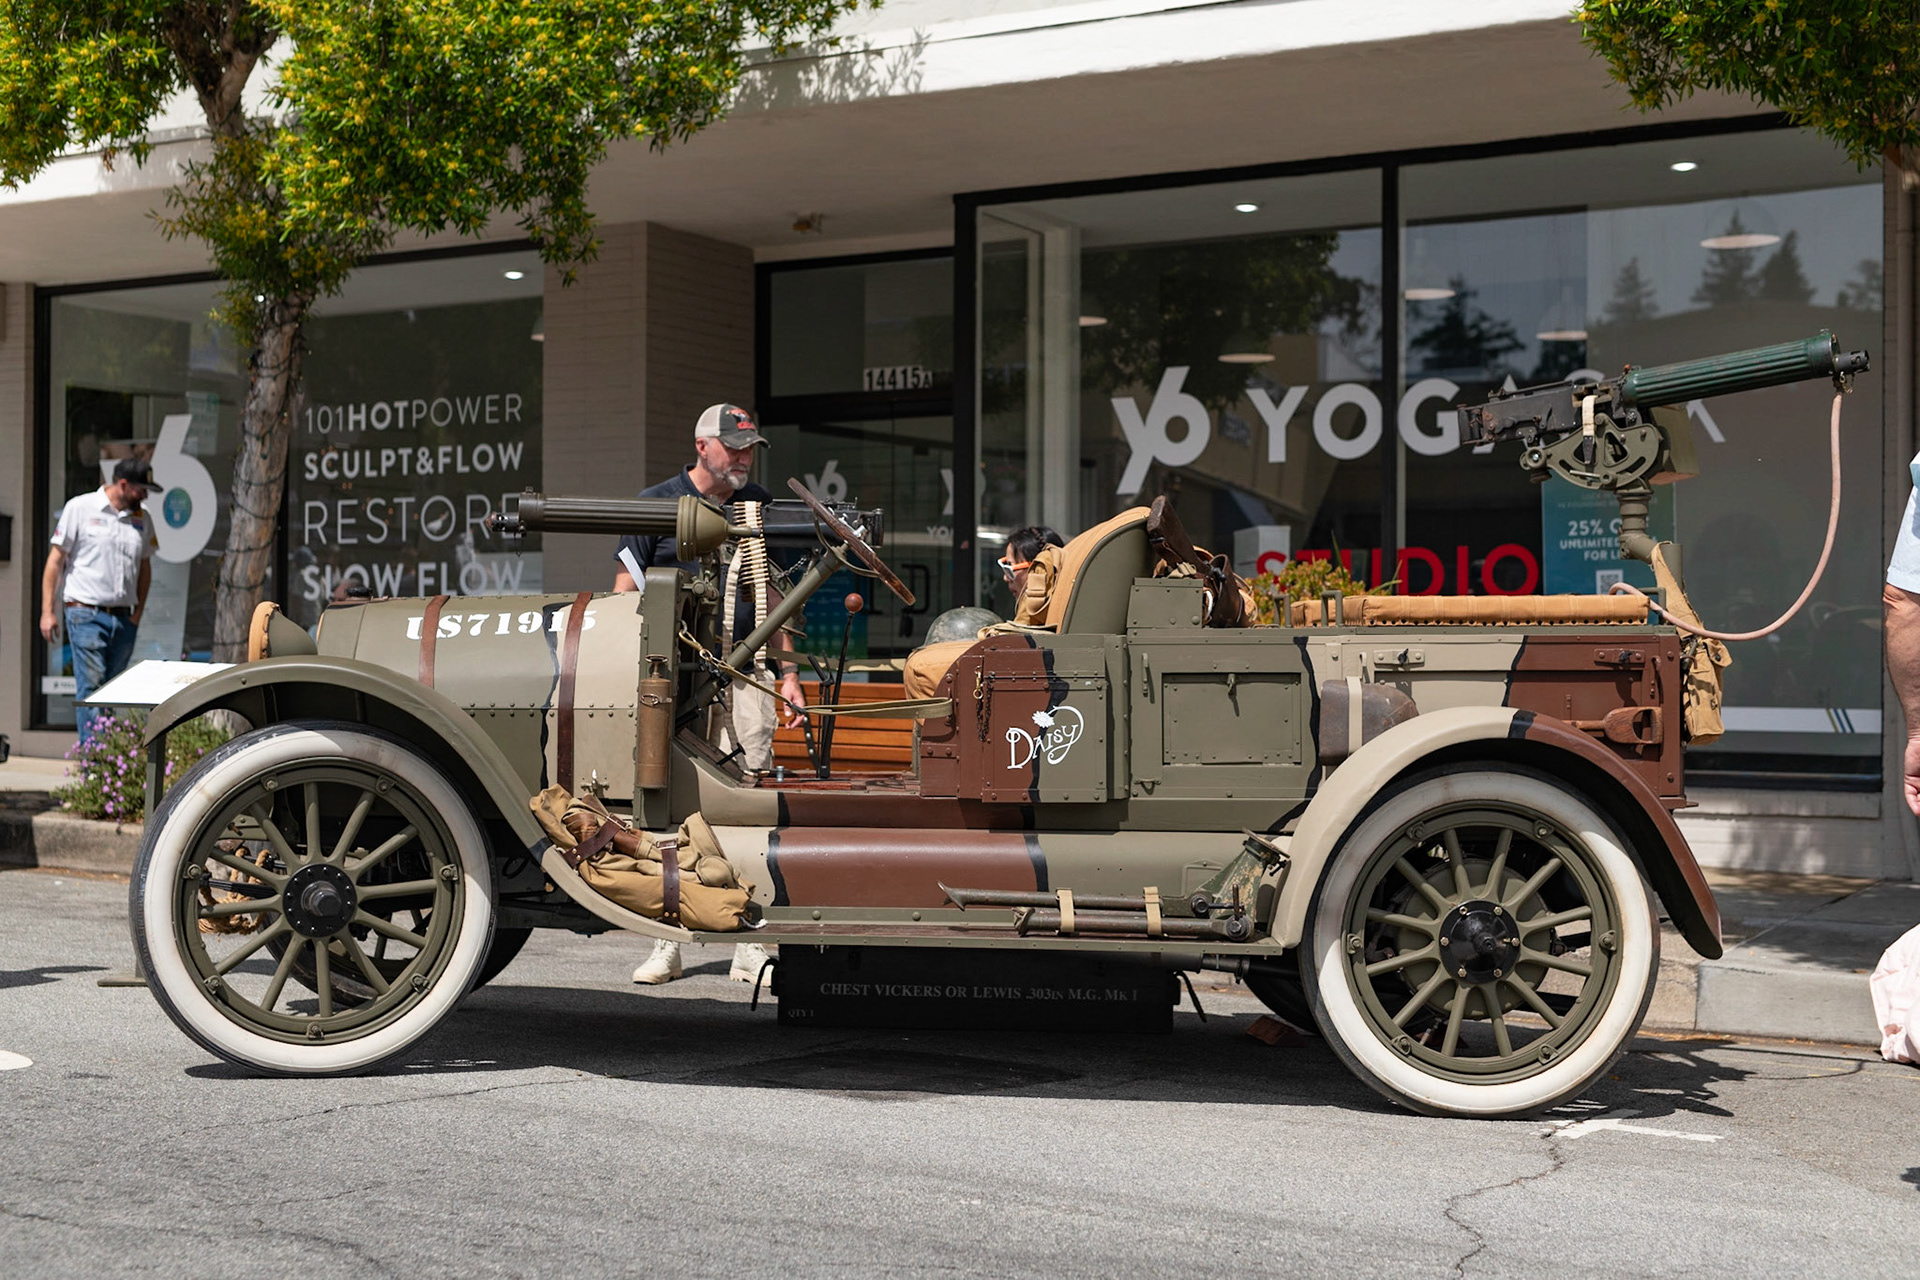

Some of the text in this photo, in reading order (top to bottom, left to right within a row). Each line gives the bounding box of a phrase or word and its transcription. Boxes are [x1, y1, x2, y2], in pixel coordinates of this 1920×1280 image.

[866, 367, 932, 390] 14415A
[305, 394, 522, 434] 101HOTPOWER
[305, 442, 523, 480] SCULPT&FLOW
[305, 493, 522, 545] RESTORE
[1568, 518, 1604, 536] 25%
[1584, 550, 1607, 560] FOR
[304, 561, 523, 600] SLOW FLOW
[820, 983, 871, 995] CHEST
[875, 984, 942, 997] VICKERS
[945, 985, 968, 998] OR
[973, 986, 1022, 999] LEWIS
[1068, 988, 1101, 1000] M.G.
[788, 1009, 808, 1018] QTY
